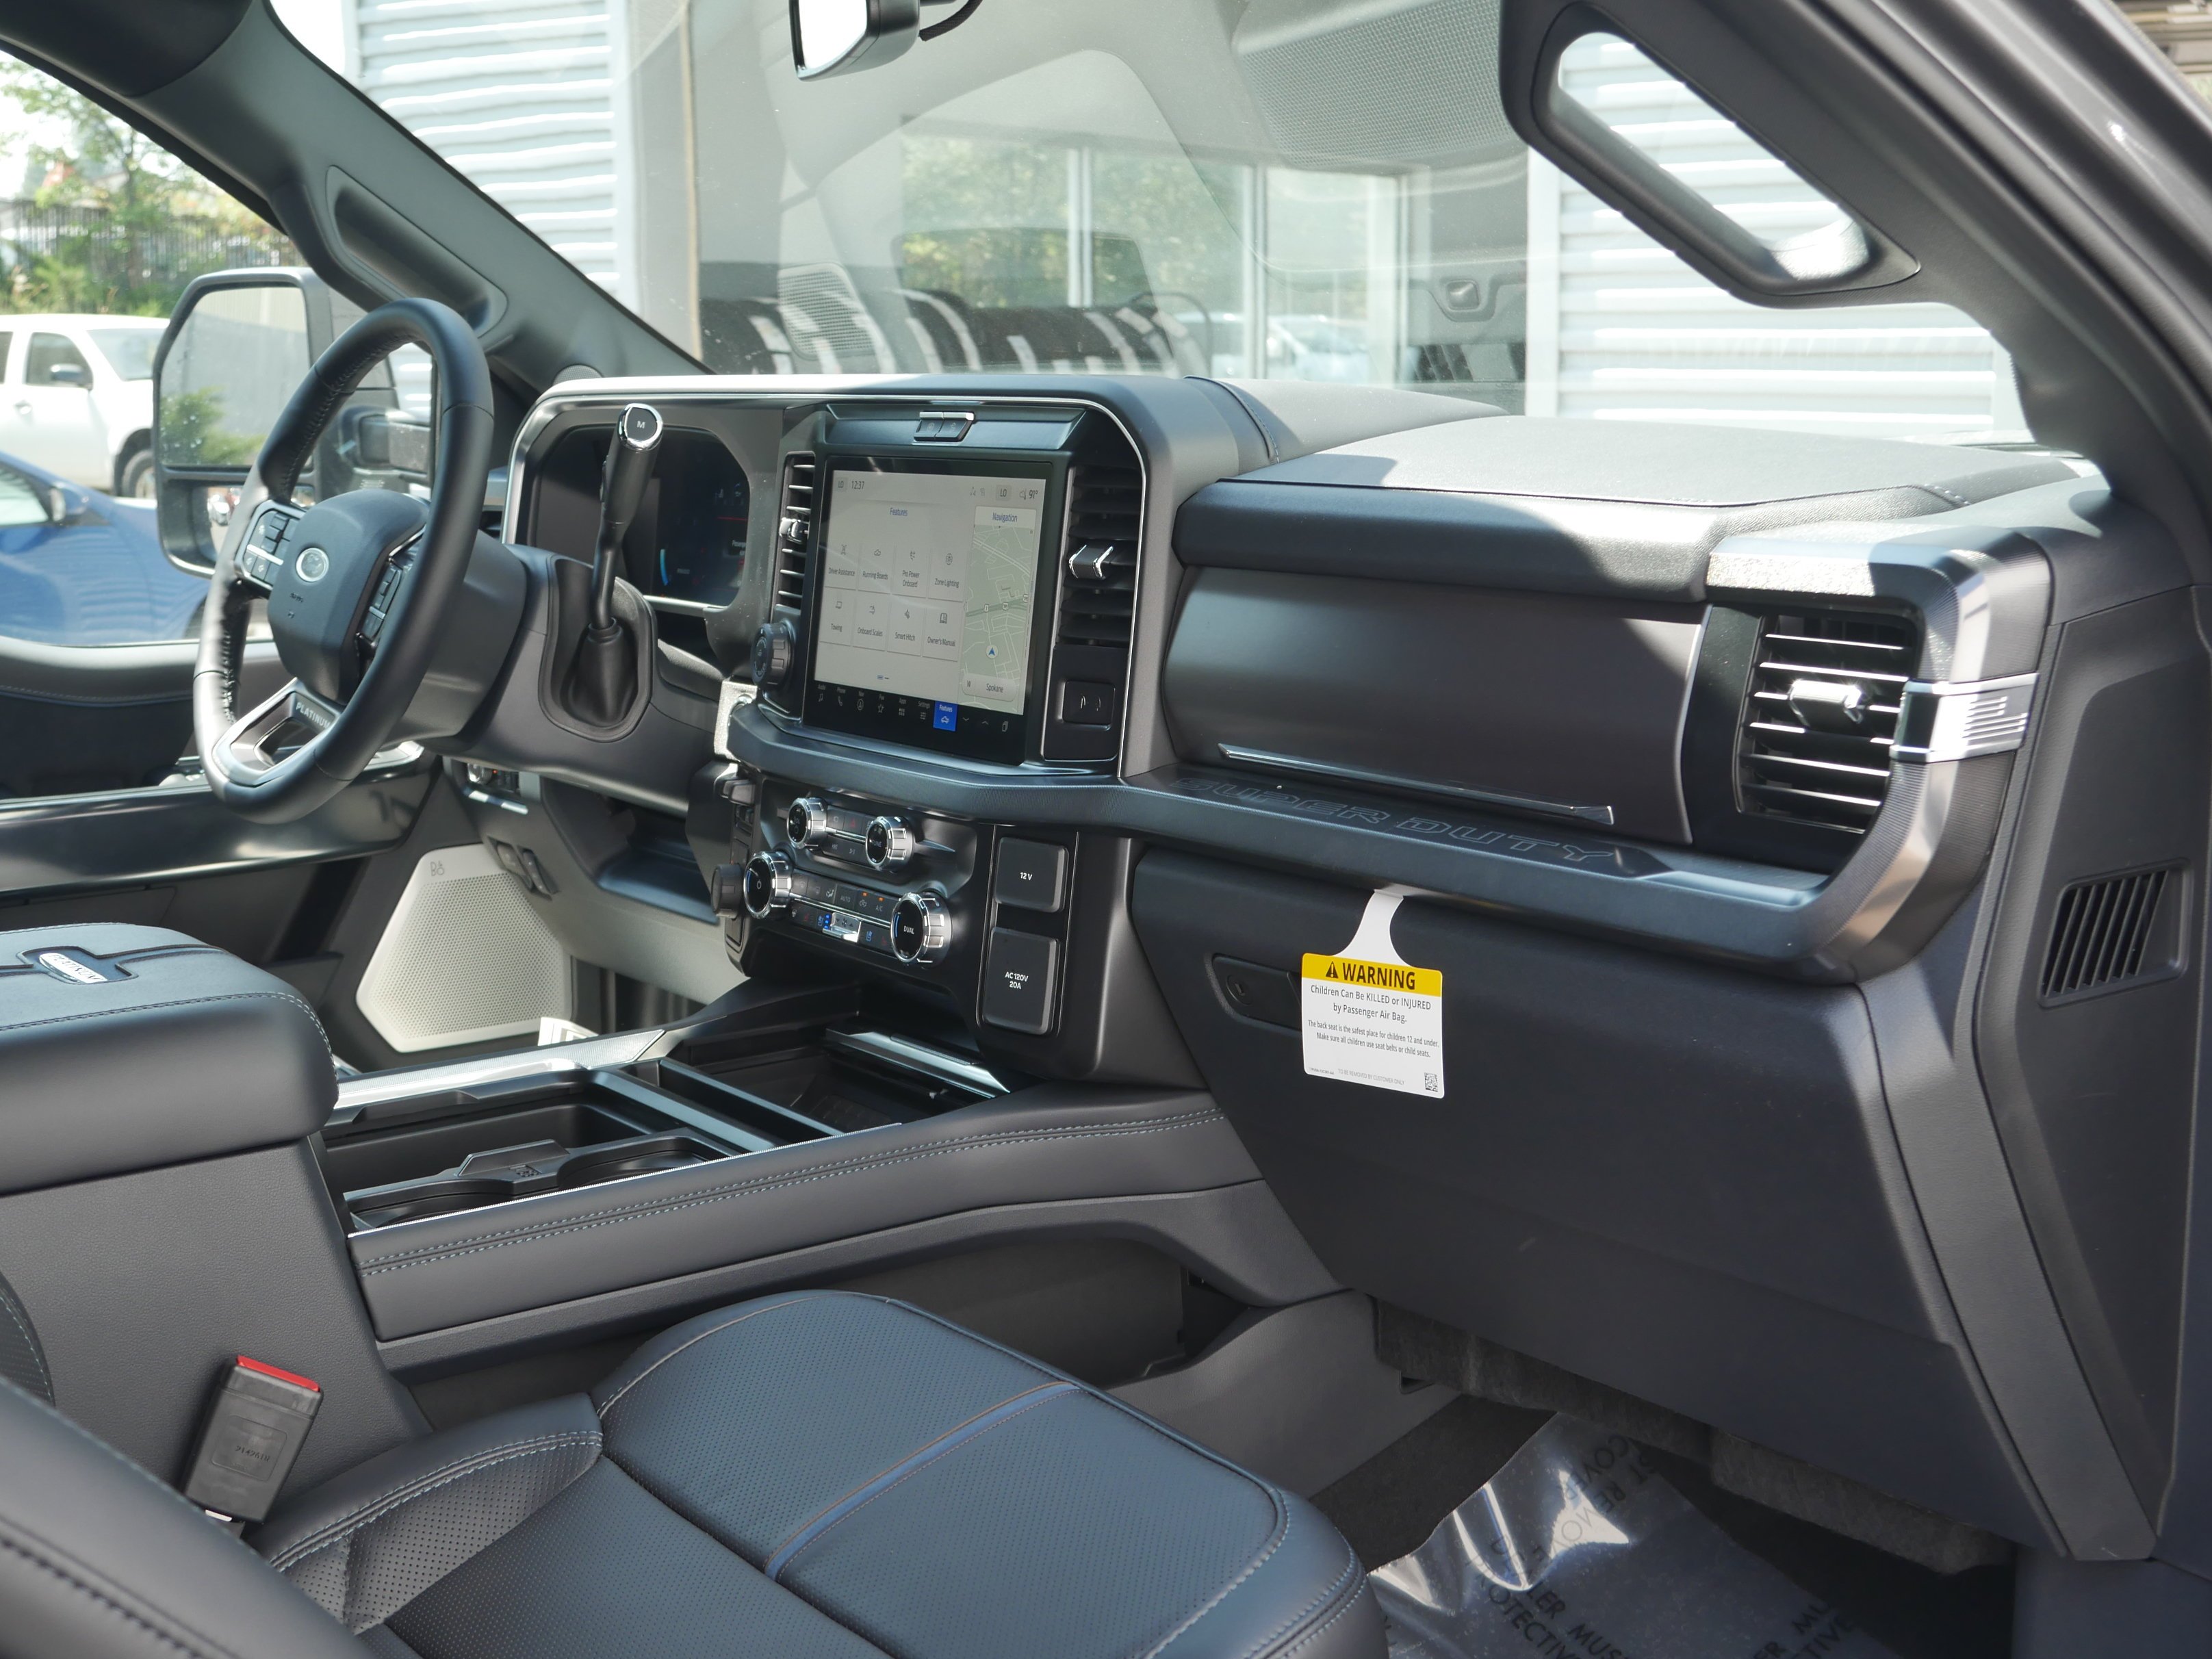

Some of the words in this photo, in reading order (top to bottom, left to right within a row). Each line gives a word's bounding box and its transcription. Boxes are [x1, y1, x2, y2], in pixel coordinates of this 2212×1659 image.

[636, 420, 645, 429] M
[851, 480, 865, 490] 12:37
[1000, 488, 1007, 498] LO
[1029, 489, 1038, 499] 91°
[889, 507, 908, 516] Features
[992, 512, 1018, 523] Navigation
[838, 568, 856, 576] Assistance
[902, 580, 918, 588] Onboard
[944, 579, 960, 589] Lighting
[831, 623, 843, 632] Towing
[857, 627, 872, 635] Onboard
[895, 632, 905, 640] Smart
[927, 636, 942, 645] Owner's
[942, 638, 956, 647] Manual
[986, 683, 1004, 693] Spokane
[939, 704, 953, 712] Features
[295, 702, 331, 729] PLATINUM
[1170, 777, 1391, 825] SUPER
[1396, 817, 1615, 862] DUTY
[903, 925, 915, 935] DUAL
[1005, 970, 1014, 979] AC
[1014, 973, 1029, 982] 120V
[1342, 962, 1415, 990] WARNING
[1009, 981, 1022, 990] 20A
[1311, 985, 1339, 996] Children
[1341, 989, 1354, 999] Can
[1356, 991, 1365, 1000] Be
[1366, 992, 1390, 1004] KILLED
[1401, 998, 1431, 1010] INJURED
[1333, 1003, 1341, 1014] by
[1343, 1004, 1378, 1019] Passenger
[1380, 1009, 1390, 1019] Air
[1392, 1012, 1407, 1025] Bag.
[1308, 1019, 1316, 1027] The
[1317, 1020, 1327, 1029] back
[1338, 1024, 1343, 1032] is
[1352, 1027, 1365, 1036] safest
[1366, 1029, 1378, 1038] place
[1387, 1031, 1406, 1042] children
[1413, 1037, 1423, 1045] and
[1424, 1038, 1439, 1048] under.
[1317, 1032, 1329, 1041] Make
[1347, 1037, 1365, 1046] children
[1375, 1042, 1385, 1051] seat
[1386, 1043, 1398, 1052] belts
[1404, 1046, 1416, 1055] child
[1417, 1049, 1431, 1058] seats.
[1349, 1070, 1367, 1079] REMOVED
[1373, 1075, 1393, 1083] CUSTOMER
